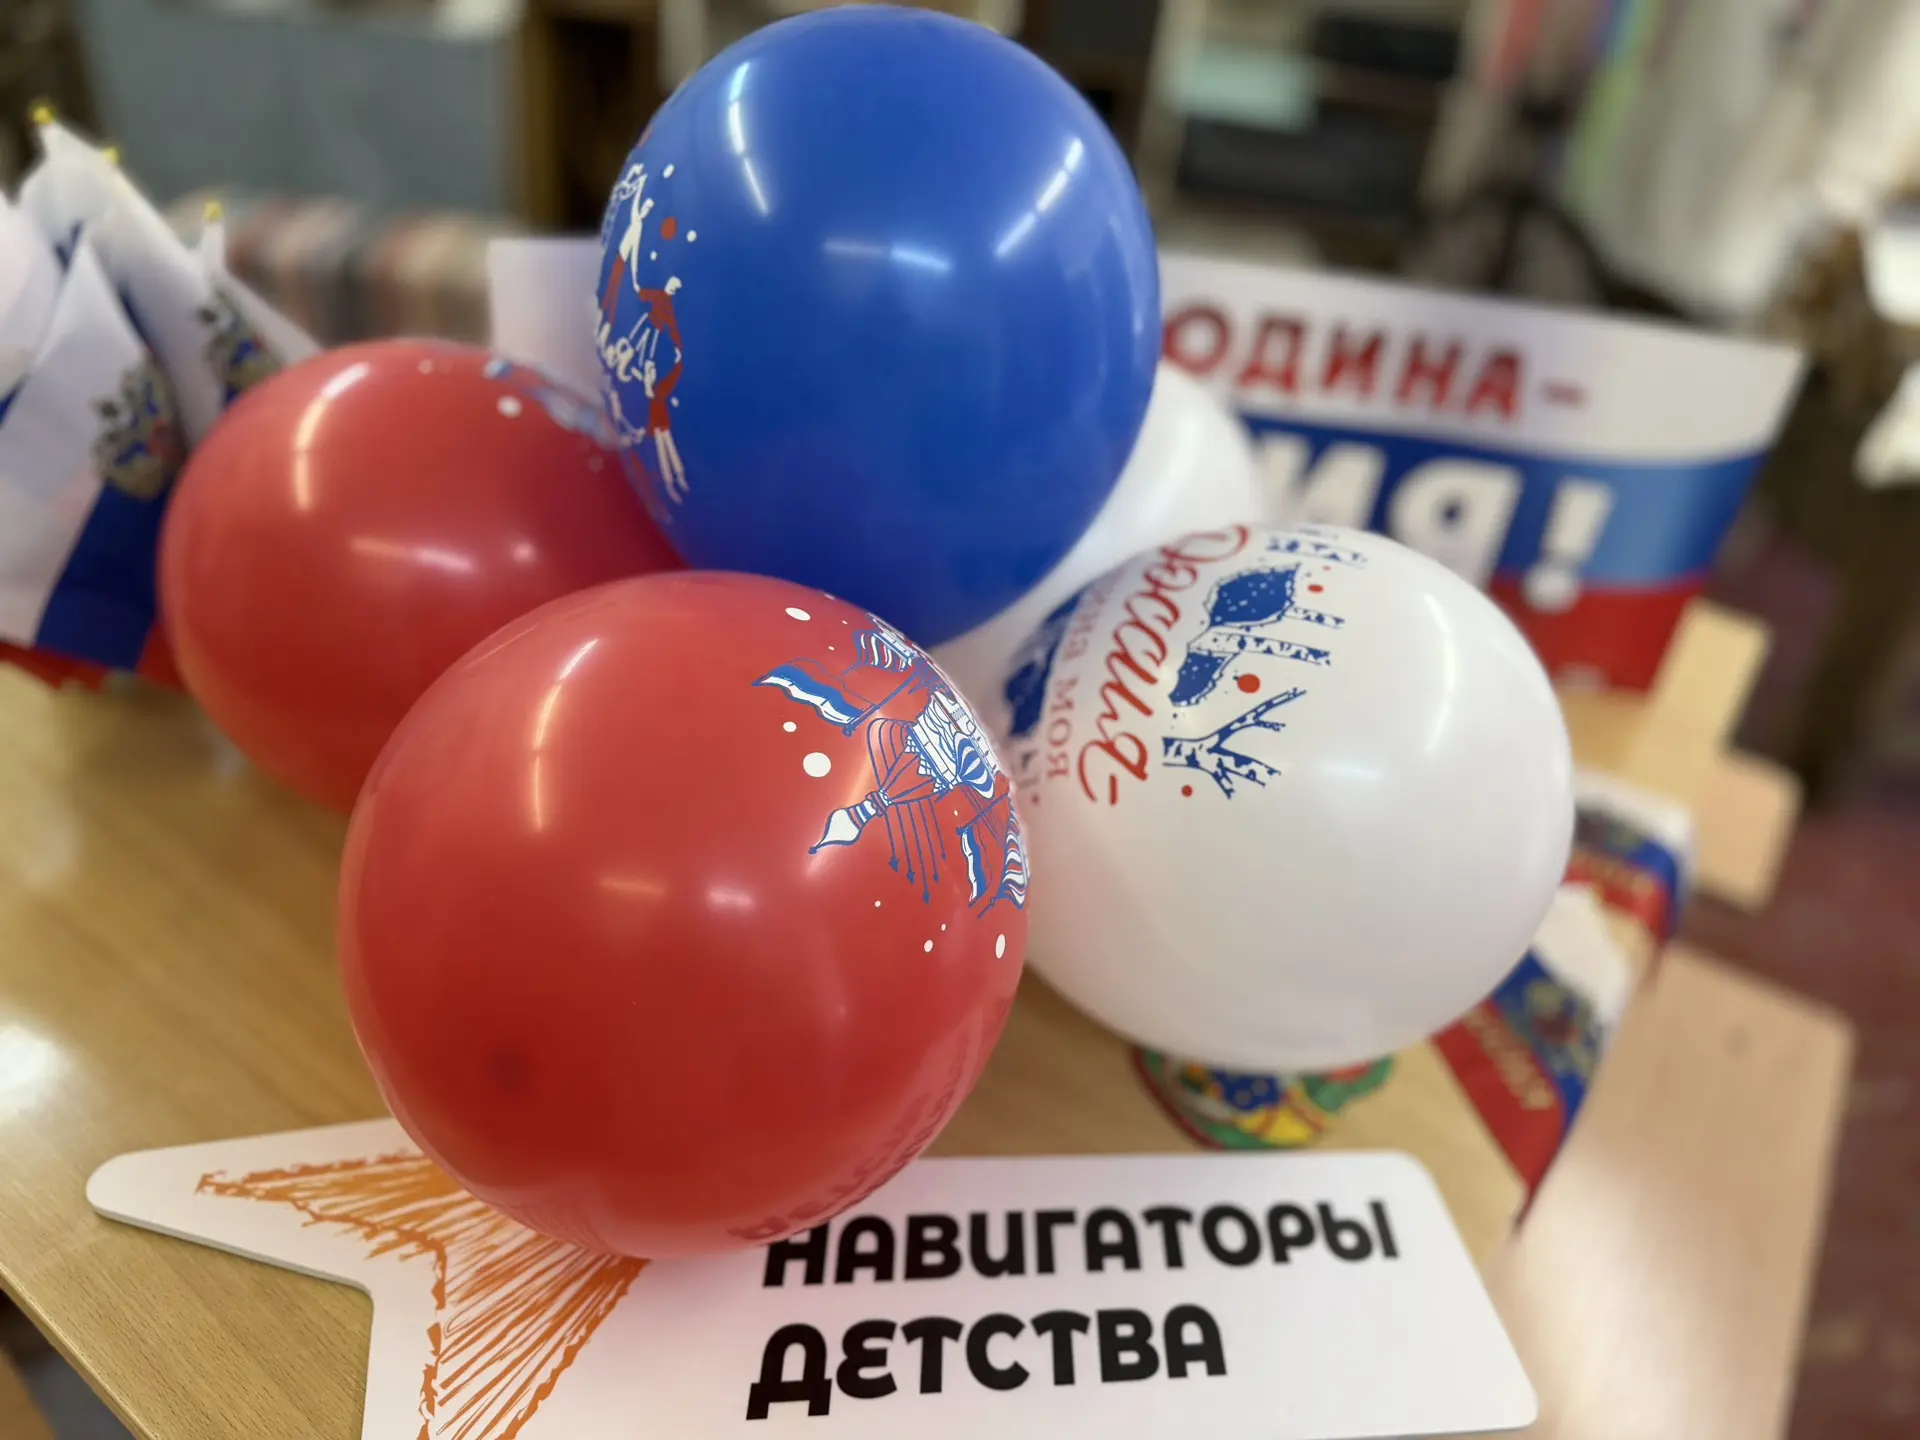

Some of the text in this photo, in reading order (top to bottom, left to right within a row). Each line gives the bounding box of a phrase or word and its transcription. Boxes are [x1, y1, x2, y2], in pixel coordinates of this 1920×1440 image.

[1160, 303, 1587, 425] ОДИНА-
[1256, 430, 1613, 612] ИЯ!
[762, 1199, 1400, 1287] НАВИГАТОРЫ
[745, 1303, 1228, 1421] ДЕТСТВА
